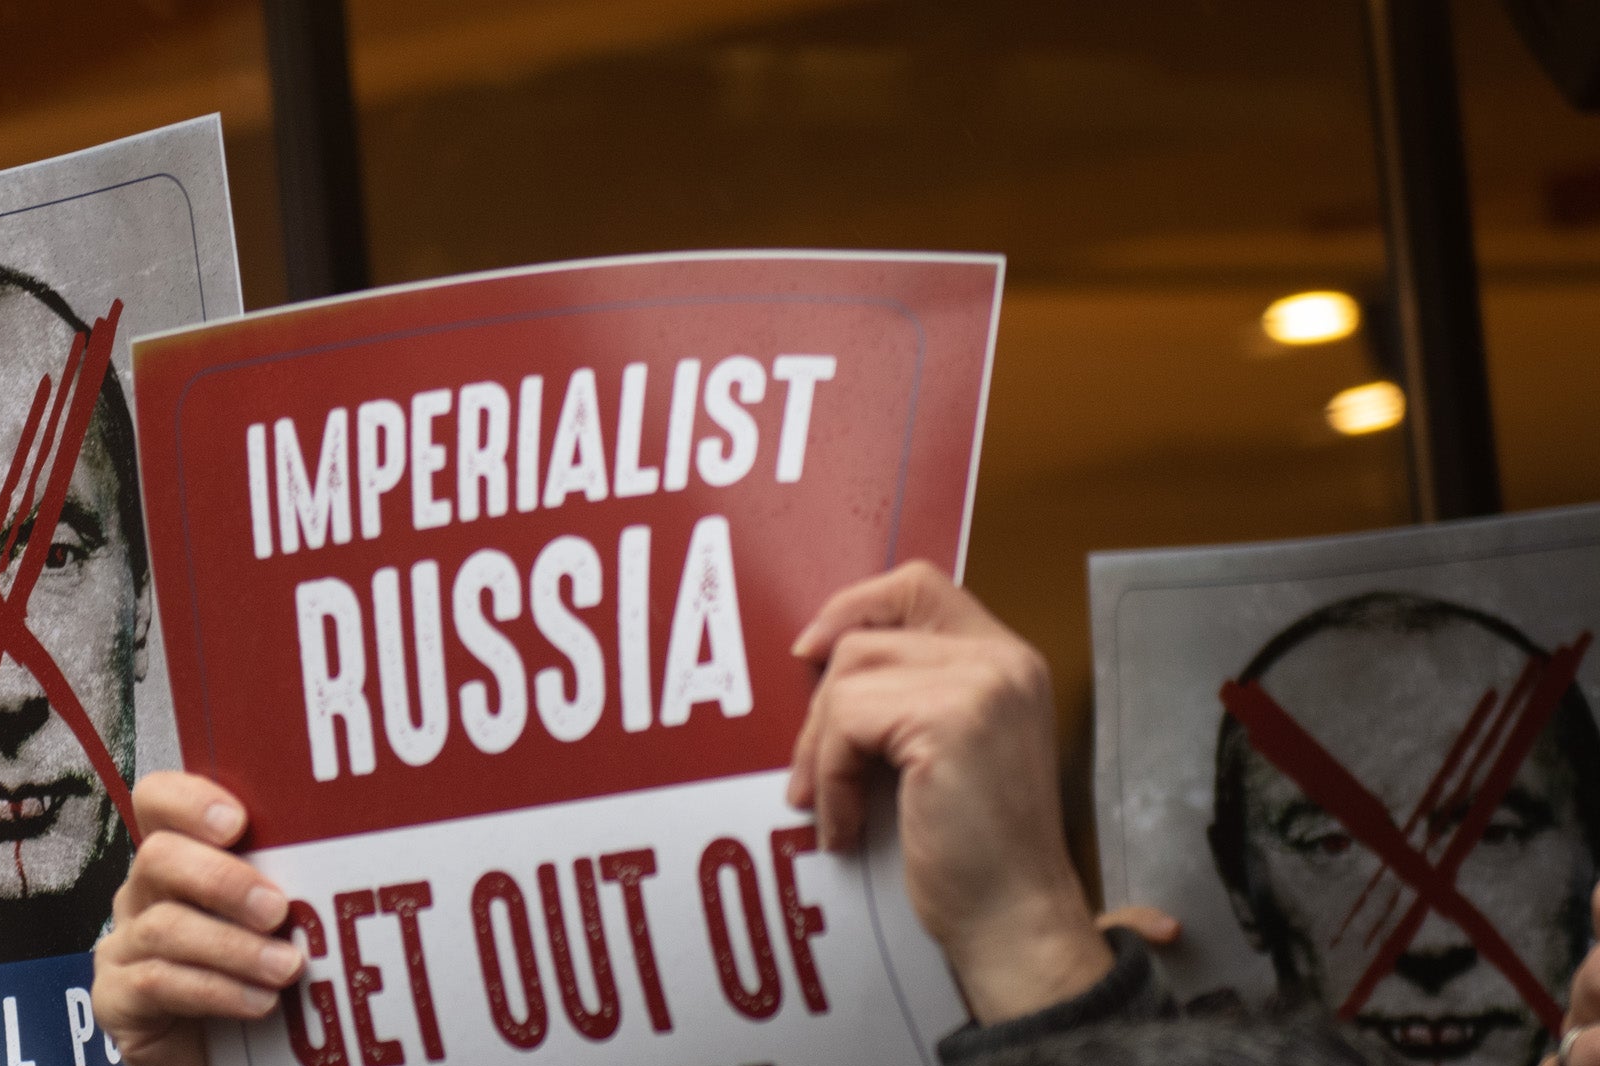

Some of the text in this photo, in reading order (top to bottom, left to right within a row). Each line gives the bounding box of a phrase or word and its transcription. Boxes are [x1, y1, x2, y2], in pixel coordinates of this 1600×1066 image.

[246, 354, 837, 559] IMPERIALIST
[294, 514, 753, 782] RUSSIA
[470, 847, 674, 1052] OUT
[699, 824, 830, 1022] OF
